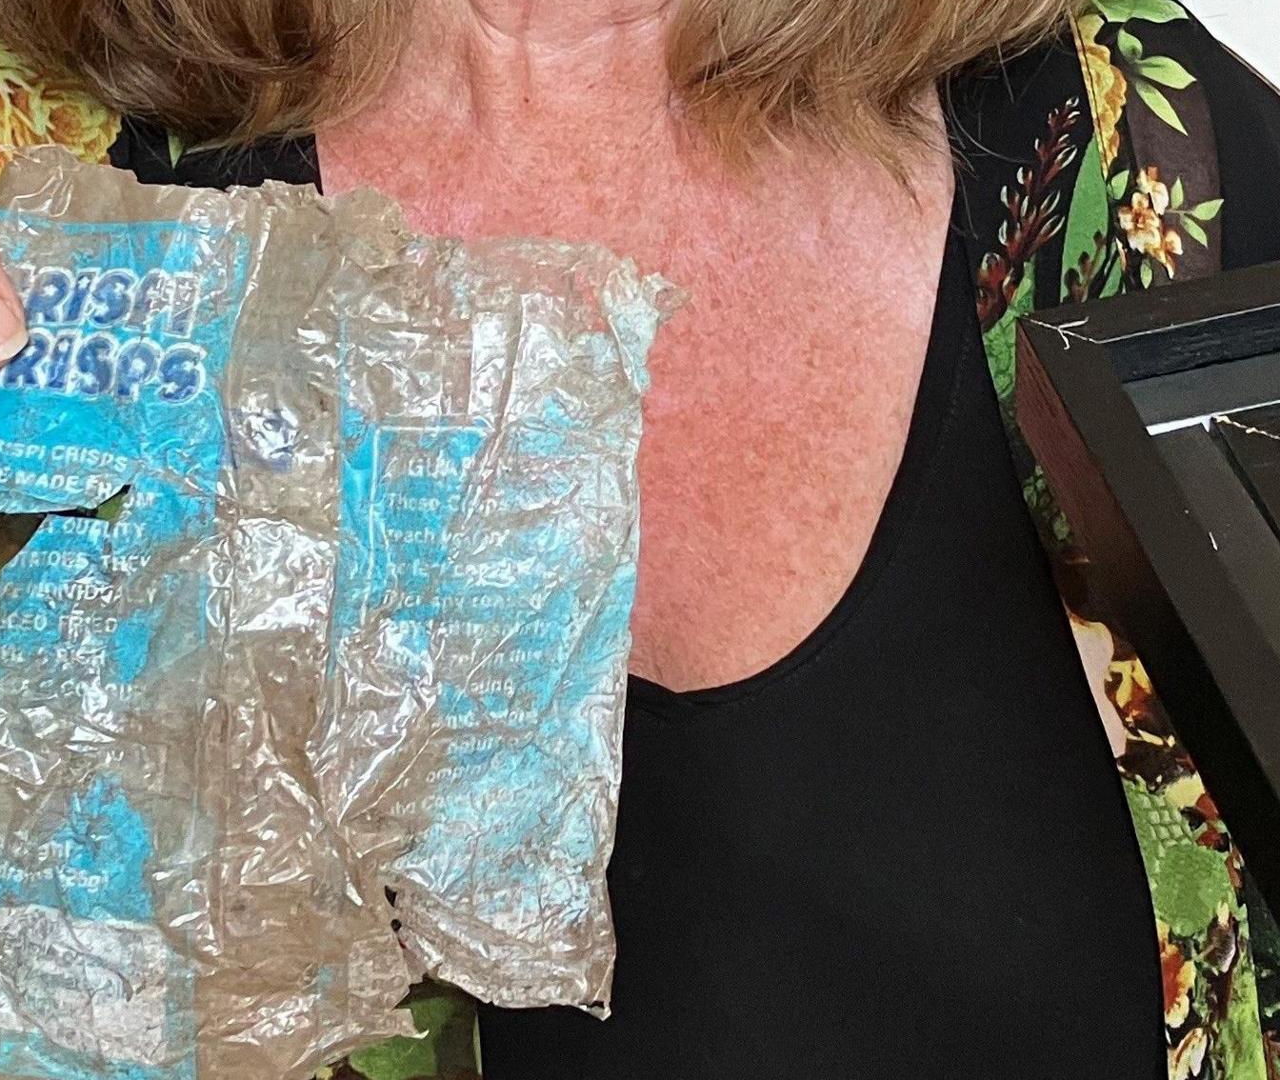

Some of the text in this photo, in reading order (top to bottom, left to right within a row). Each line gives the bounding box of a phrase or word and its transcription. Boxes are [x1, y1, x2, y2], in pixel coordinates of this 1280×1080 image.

[51, 444, 129, 472] CRISPS
[15, 471, 82, 492] MADE
[102, 555, 151, 574] THEY
